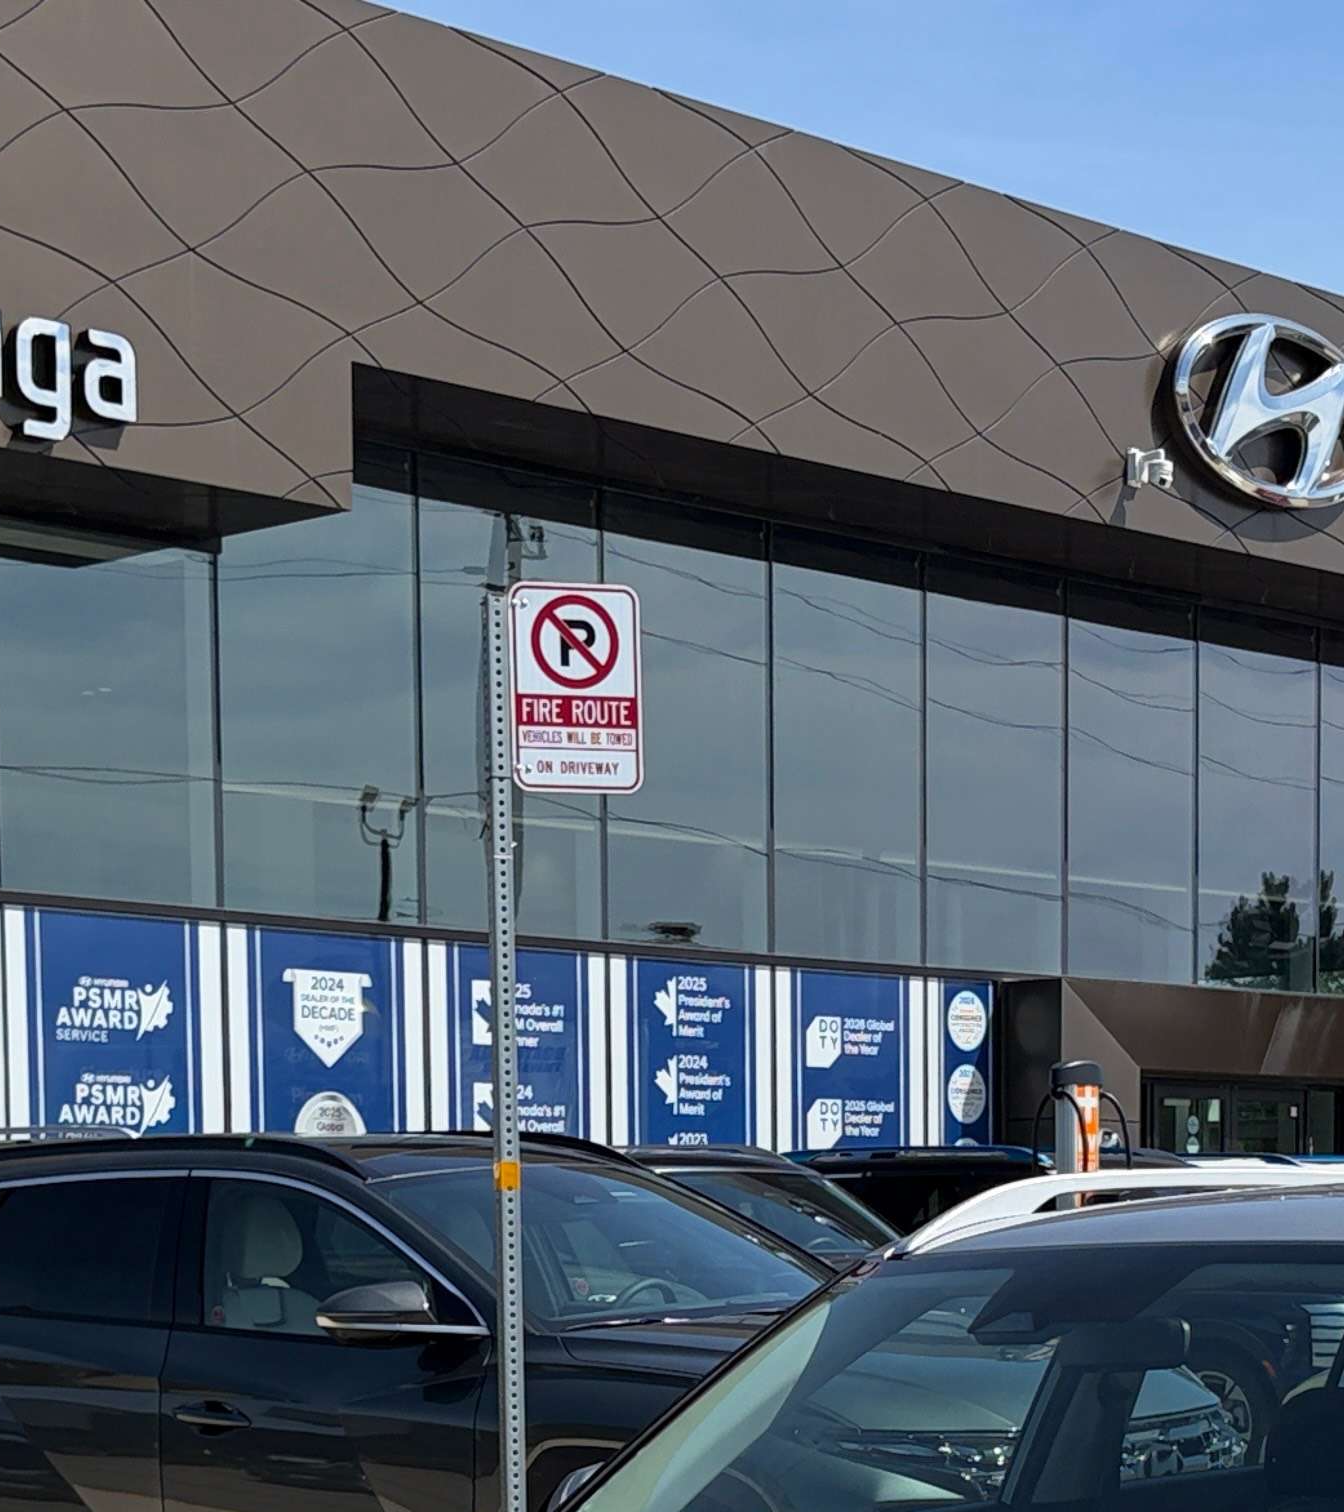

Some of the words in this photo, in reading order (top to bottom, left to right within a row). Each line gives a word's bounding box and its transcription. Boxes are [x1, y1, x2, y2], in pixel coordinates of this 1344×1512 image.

[521, 698, 563, 723] FIRE
[572, 700, 632, 726] ROUTE
[522, 730, 563, 744] VEHICLES
[567, 731, 586, 745] WILL
[591, 732, 602, 745] BE
[606, 733, 632, 746] TOWED
[537, 761, 553, 774] ON
[561, 761, 619, 776] DRIVEWAY
[310, 976, 344, 992] 2024
[678, 976, 707, 991] 2025
[72, 986, 139, 1010] PSMR
[515, 983, 532, 999] 25
[300, 993, 329, 1003] DEALER
[330, 995, 339, 1003] OF
[342, 996, 355, 1004] THE
[678, 994, 731, 1009] President's
[301, 1005, 356, 1021] DECADE
[515, 1003, 550, 1017] nada's
[678, 1009, 710, 1022] Award
[712, 1010, 722, 1023] of
[56, 1006, 138, 1030] AWARD
[526, 1018, 564, 1032] Overall
[866, 1019, 894, 1031] Global
[678, 1025, 704, 1038] Merit
[819, 1019, 839, 1033] DO
[56, 1028, 109, 1042] SERVICE
[843, 1031, 872, 1042] Dealer
[872, 1031, 882, 1043] of
[819, 1035, 838, 1050] TY
[844, 1043, 859, 1055] the
[859, 1044, 879, 1055] Year
[678, 1054, 708, 1069] 2024
[679, 1072, 731, 1086] President's
[75, 1083, 141, 1106] PSMR
[516, 1085, 533, 1100] 24
[679, 1088, 711, 1100] Award
[712, 1089, 722, 1101] of
[517, 1104, 552, 1117] nada's
[679, 1102, 705, 1116] Merit
[820, 1102, 839, 1115] DO
[867, 1101, 894, 1112] Global
[58, 1104, 141, 1125] AWARD
[844, 1112, 872, 1124] Dealer
[873, 1112, 883, 1124] of
[820, 1118, 839, 1132] TY
[845, 1125, 859, 1136] the
[860, 1126, 880, 1137] Year
